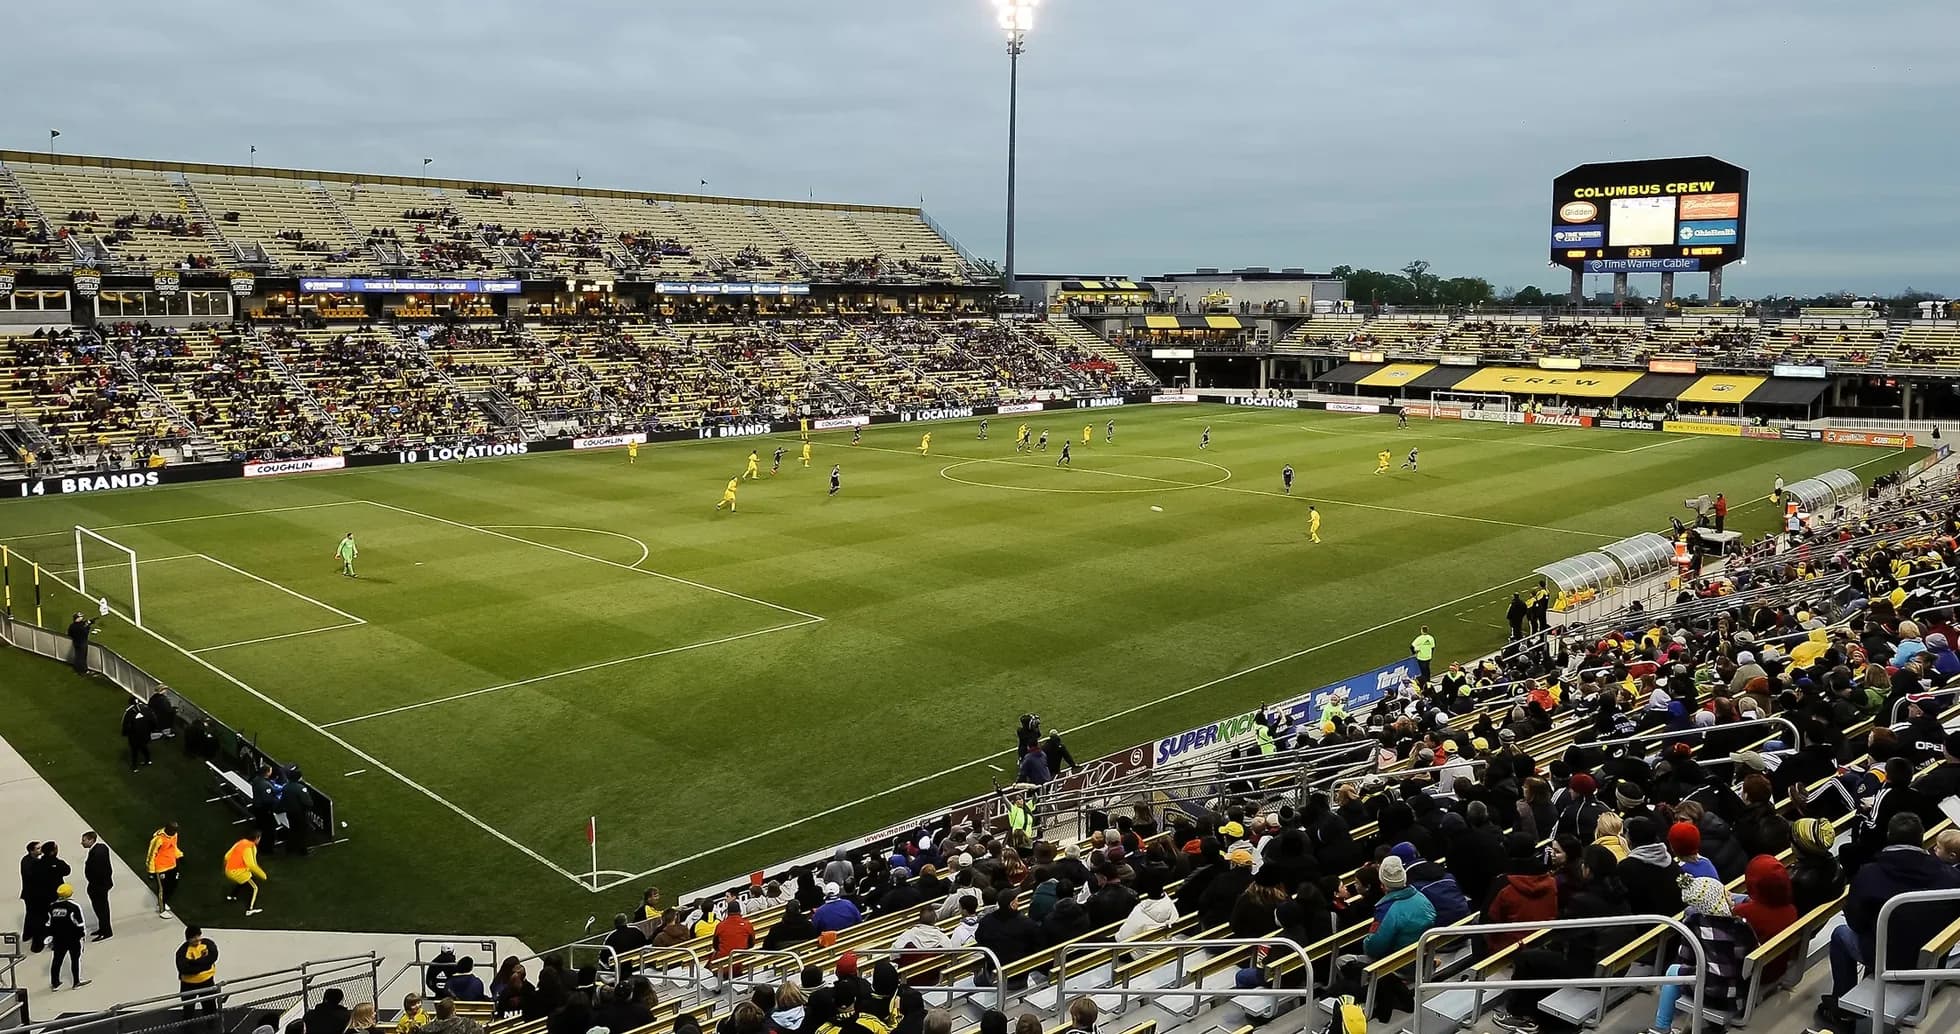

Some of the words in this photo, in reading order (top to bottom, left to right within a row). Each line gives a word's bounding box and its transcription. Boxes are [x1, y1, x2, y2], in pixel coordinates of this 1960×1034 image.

[1574, 185, 1660, 198] COLUMBUS
[1665, 181, 1715, 193] CREW
[1603, 259, 1626, 269] Time
[1627, 259, 1662, 268] Warner
[1663, 258, 1690, 268] Cable
[1502, 375, 1600, 386] CREW
[1076, 399, 1086, 408] 14
[1090, 397, 1124, 407] BRANDS
[1225, 396, 1235, 405] 10
[1240, 397, 1298, 409] LOCATIONS
[900, 413, 911, 422] 10
[917, 408, 973, 420] LOCATIONS
[1533, 413, 1582, 426] makita
[1621, 417, 1653, 430] adidas
[699, 428, 712, 439] 14
[719, 424, 771, 437] BRANDS
[582, 437, 624, 446] COUGHLIN
[400, 451, 417, 463] 10
[428, 442, 528, 461] LOCATIONS
[257, 461, 313, 474] COUGHLIN
[21, 480, 45, 497] 14
[61, 472, 159, 494] BRANDS
